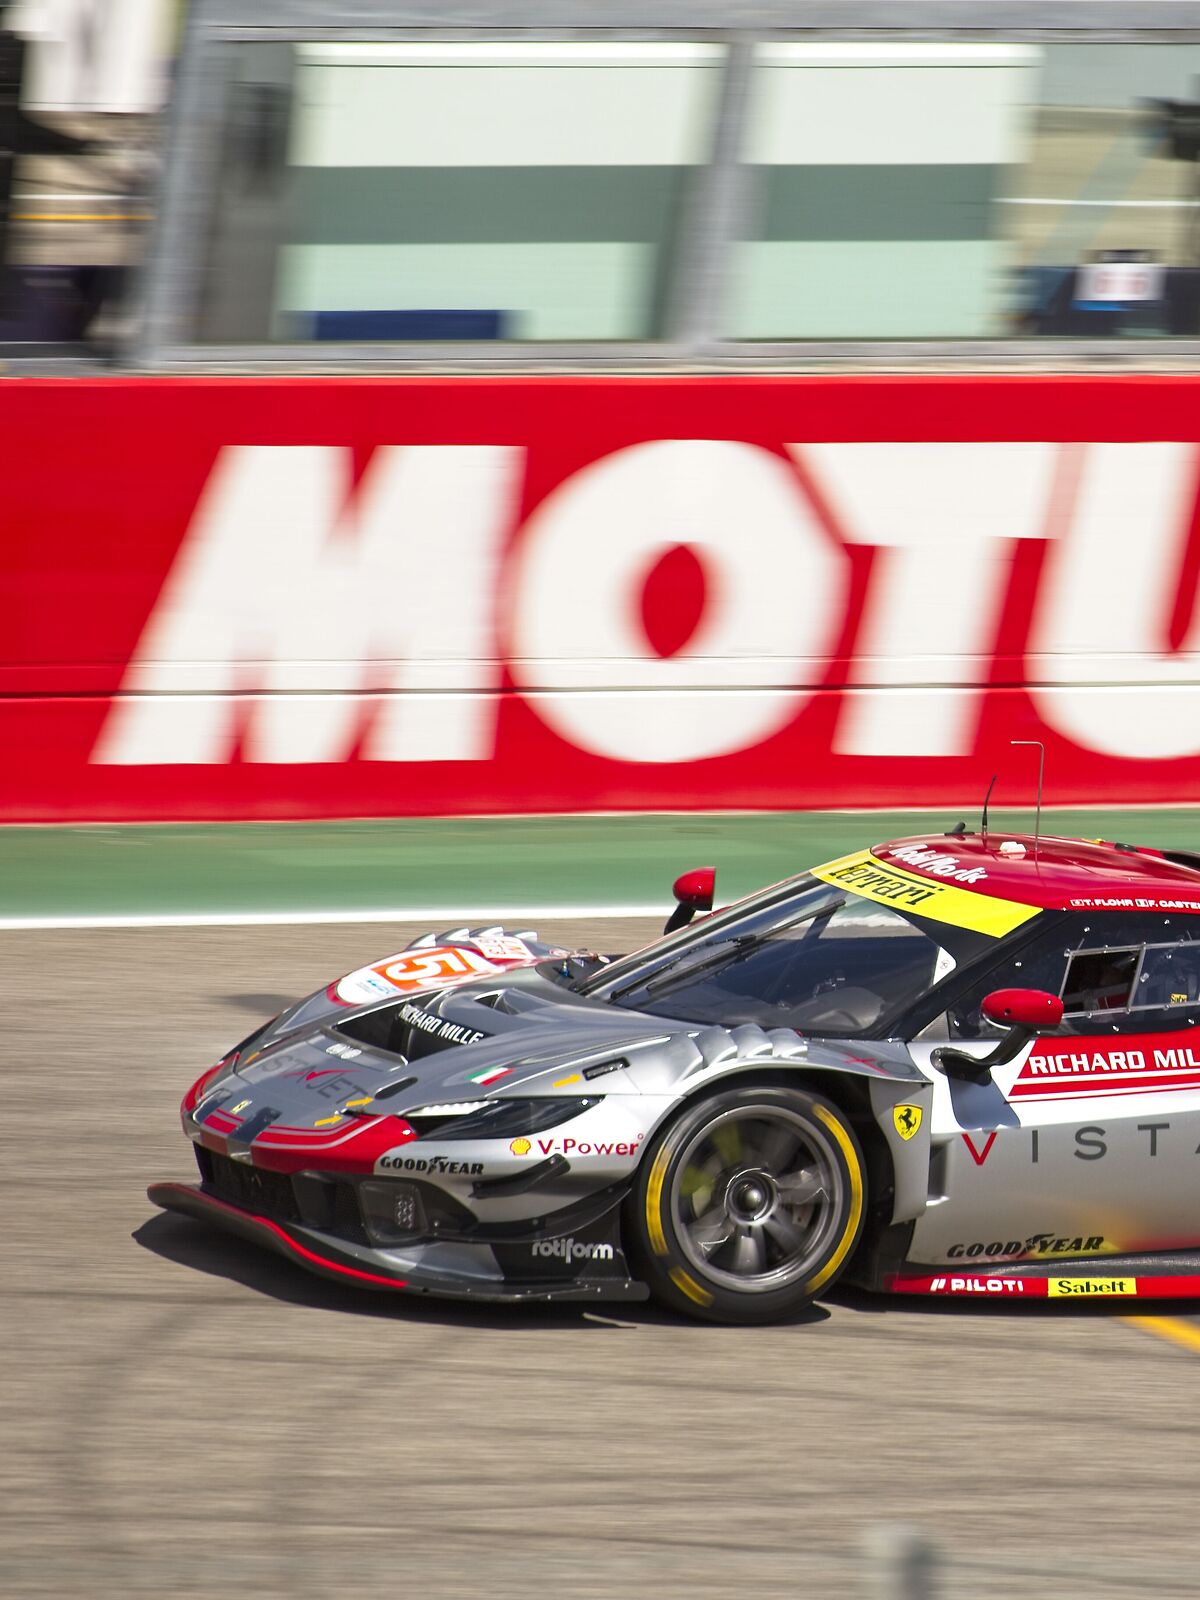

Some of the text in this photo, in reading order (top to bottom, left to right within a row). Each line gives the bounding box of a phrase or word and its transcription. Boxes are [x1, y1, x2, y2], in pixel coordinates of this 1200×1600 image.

[829, 861, 946, 906] Ferrari
[1094, 898, 1134, 907] FLOHR
[384, 951, 470, 987] 5
[438, 1022, 485, 1045] MILLE
[1029, 1049, 1147, 1076] RICHARD
[537, 1138, 640, 1157] V-Power
[379, 1155, 485, 1175] GOODYEAR
[531, 1238, 614, 1265] rotiform
[946, 1233, 1105, 1260] GOODYEAR
[951, 1278, 1025, 1293] PILOTI
[1057, 1279, 1127, 1295] Sabelt
